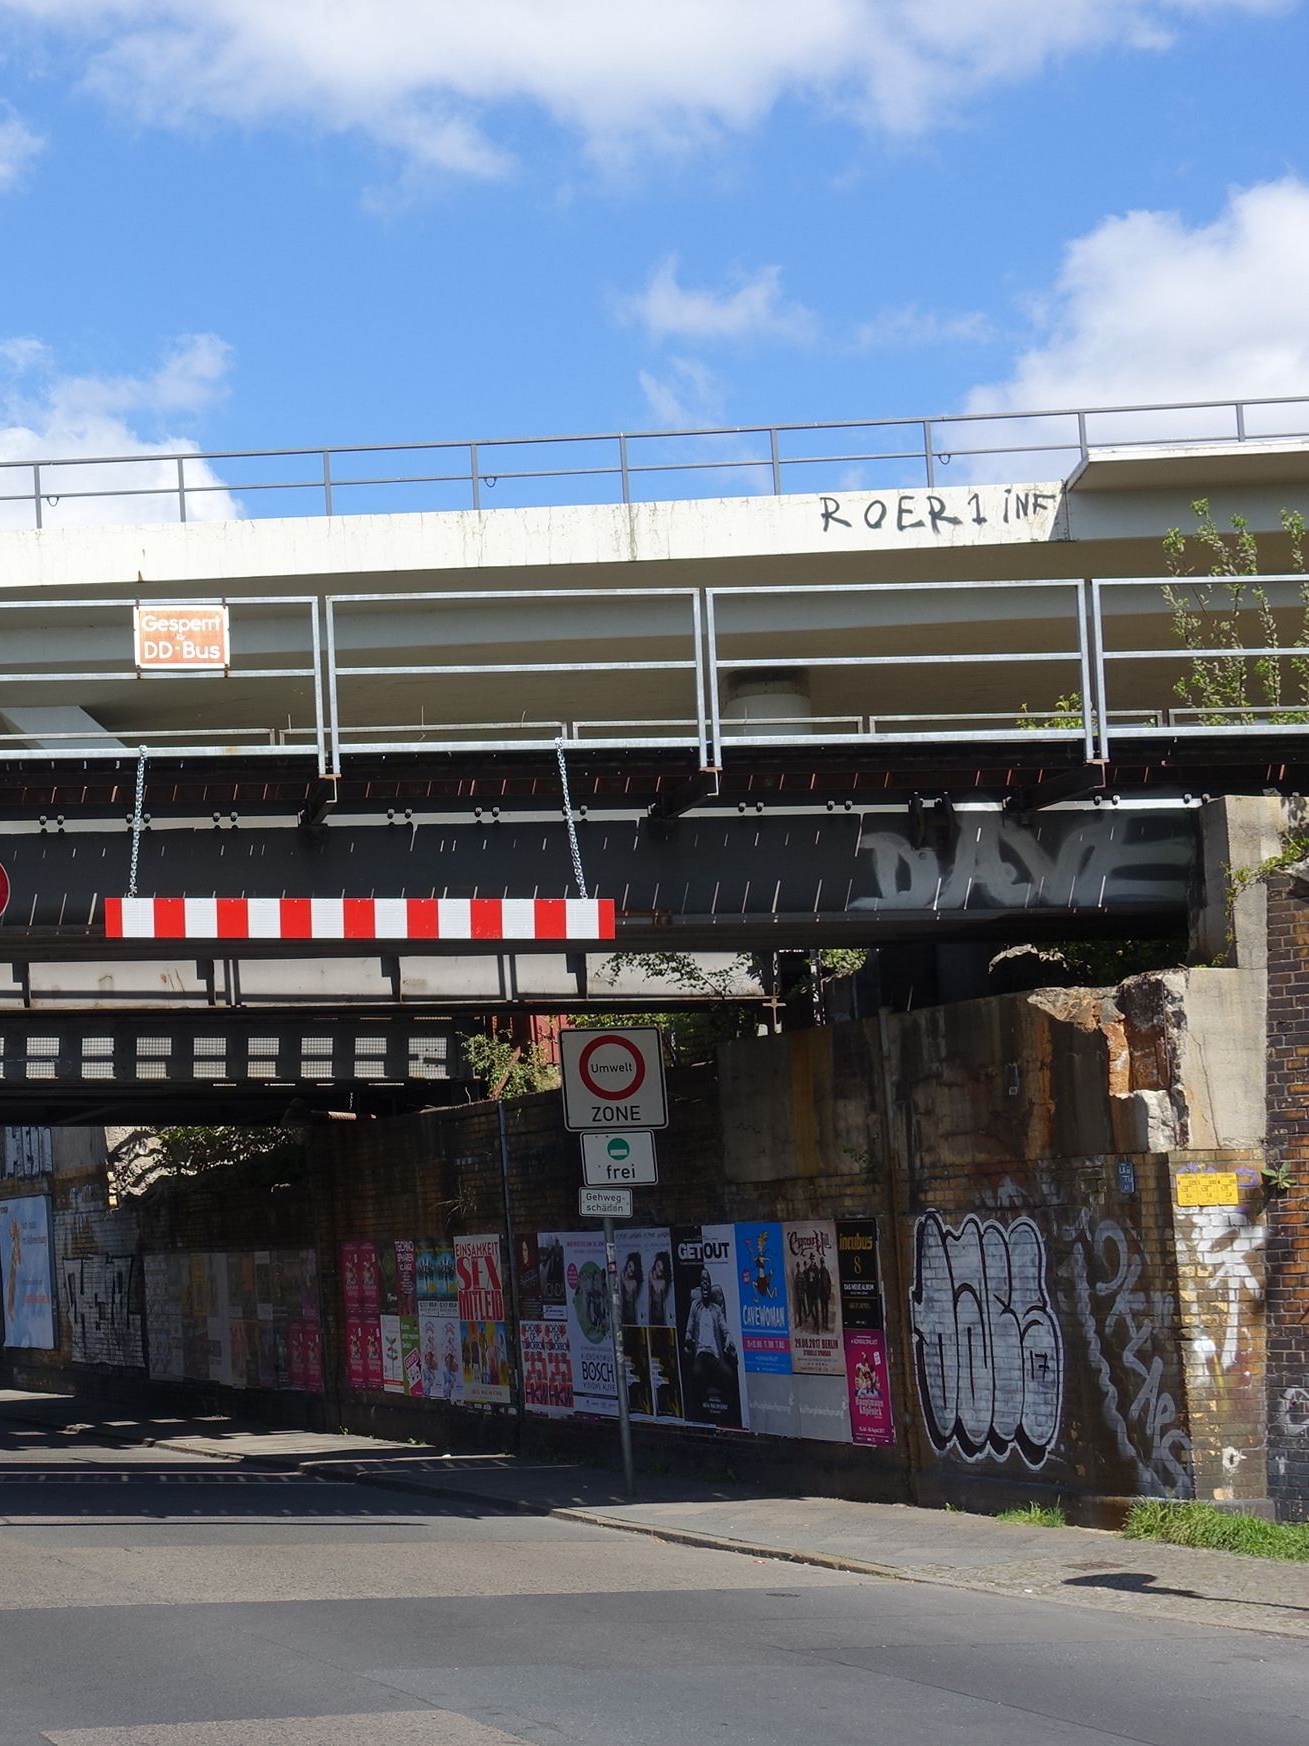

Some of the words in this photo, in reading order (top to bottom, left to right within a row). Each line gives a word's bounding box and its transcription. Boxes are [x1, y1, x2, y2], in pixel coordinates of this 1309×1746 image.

[142, 614, 222, 634] Gesperrt
[591, 1062, 633, 1074] Umwelt
[591, 1106, 641, 1122] ZONE
[607, 1164, 636, 1179] frei
[585, 1193, 625, 1205] Gehweg-
[586, 1203, 624, 1213] schäden
[455, 1241, 499, 1258] EINSAMKEIT
[839, 1232, 874, 1251] incubus
[677, 1242, 703, 1261] GET
[703, 1242, 730, 1260] OUT
[456, 1256, 502, 1291] SEX
[458, 1289, 504, 1322] MITLEID
[742, 1304, 787, 1328] CAVEWOMAN
[581, 1361, 615, 1383] BOSCH
